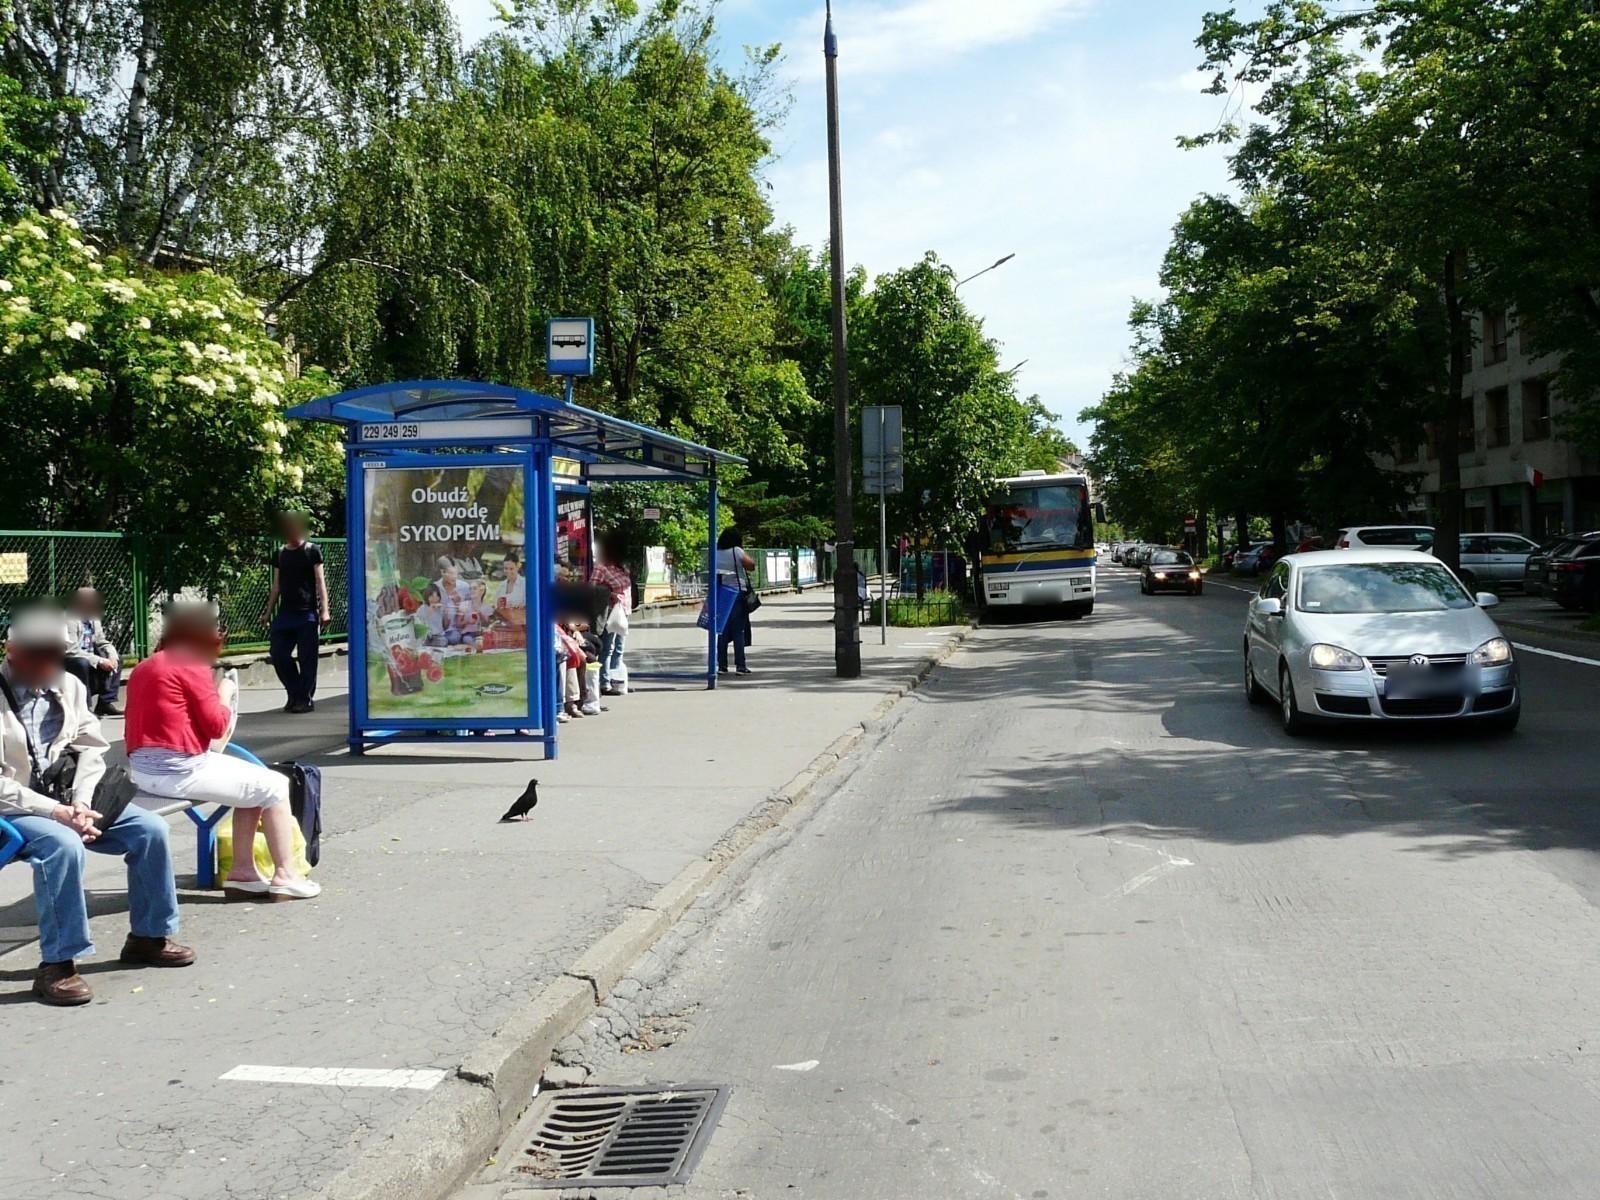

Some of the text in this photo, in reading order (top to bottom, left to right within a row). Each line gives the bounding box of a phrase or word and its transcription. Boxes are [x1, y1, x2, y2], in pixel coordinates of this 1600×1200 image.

[363, 424, 418, 439] 229 249 259
[411, 486, 468, 504] Obudź
[441, 502, 488, 523] wodę
[400, 524, 500, 542] SYROPEM!
